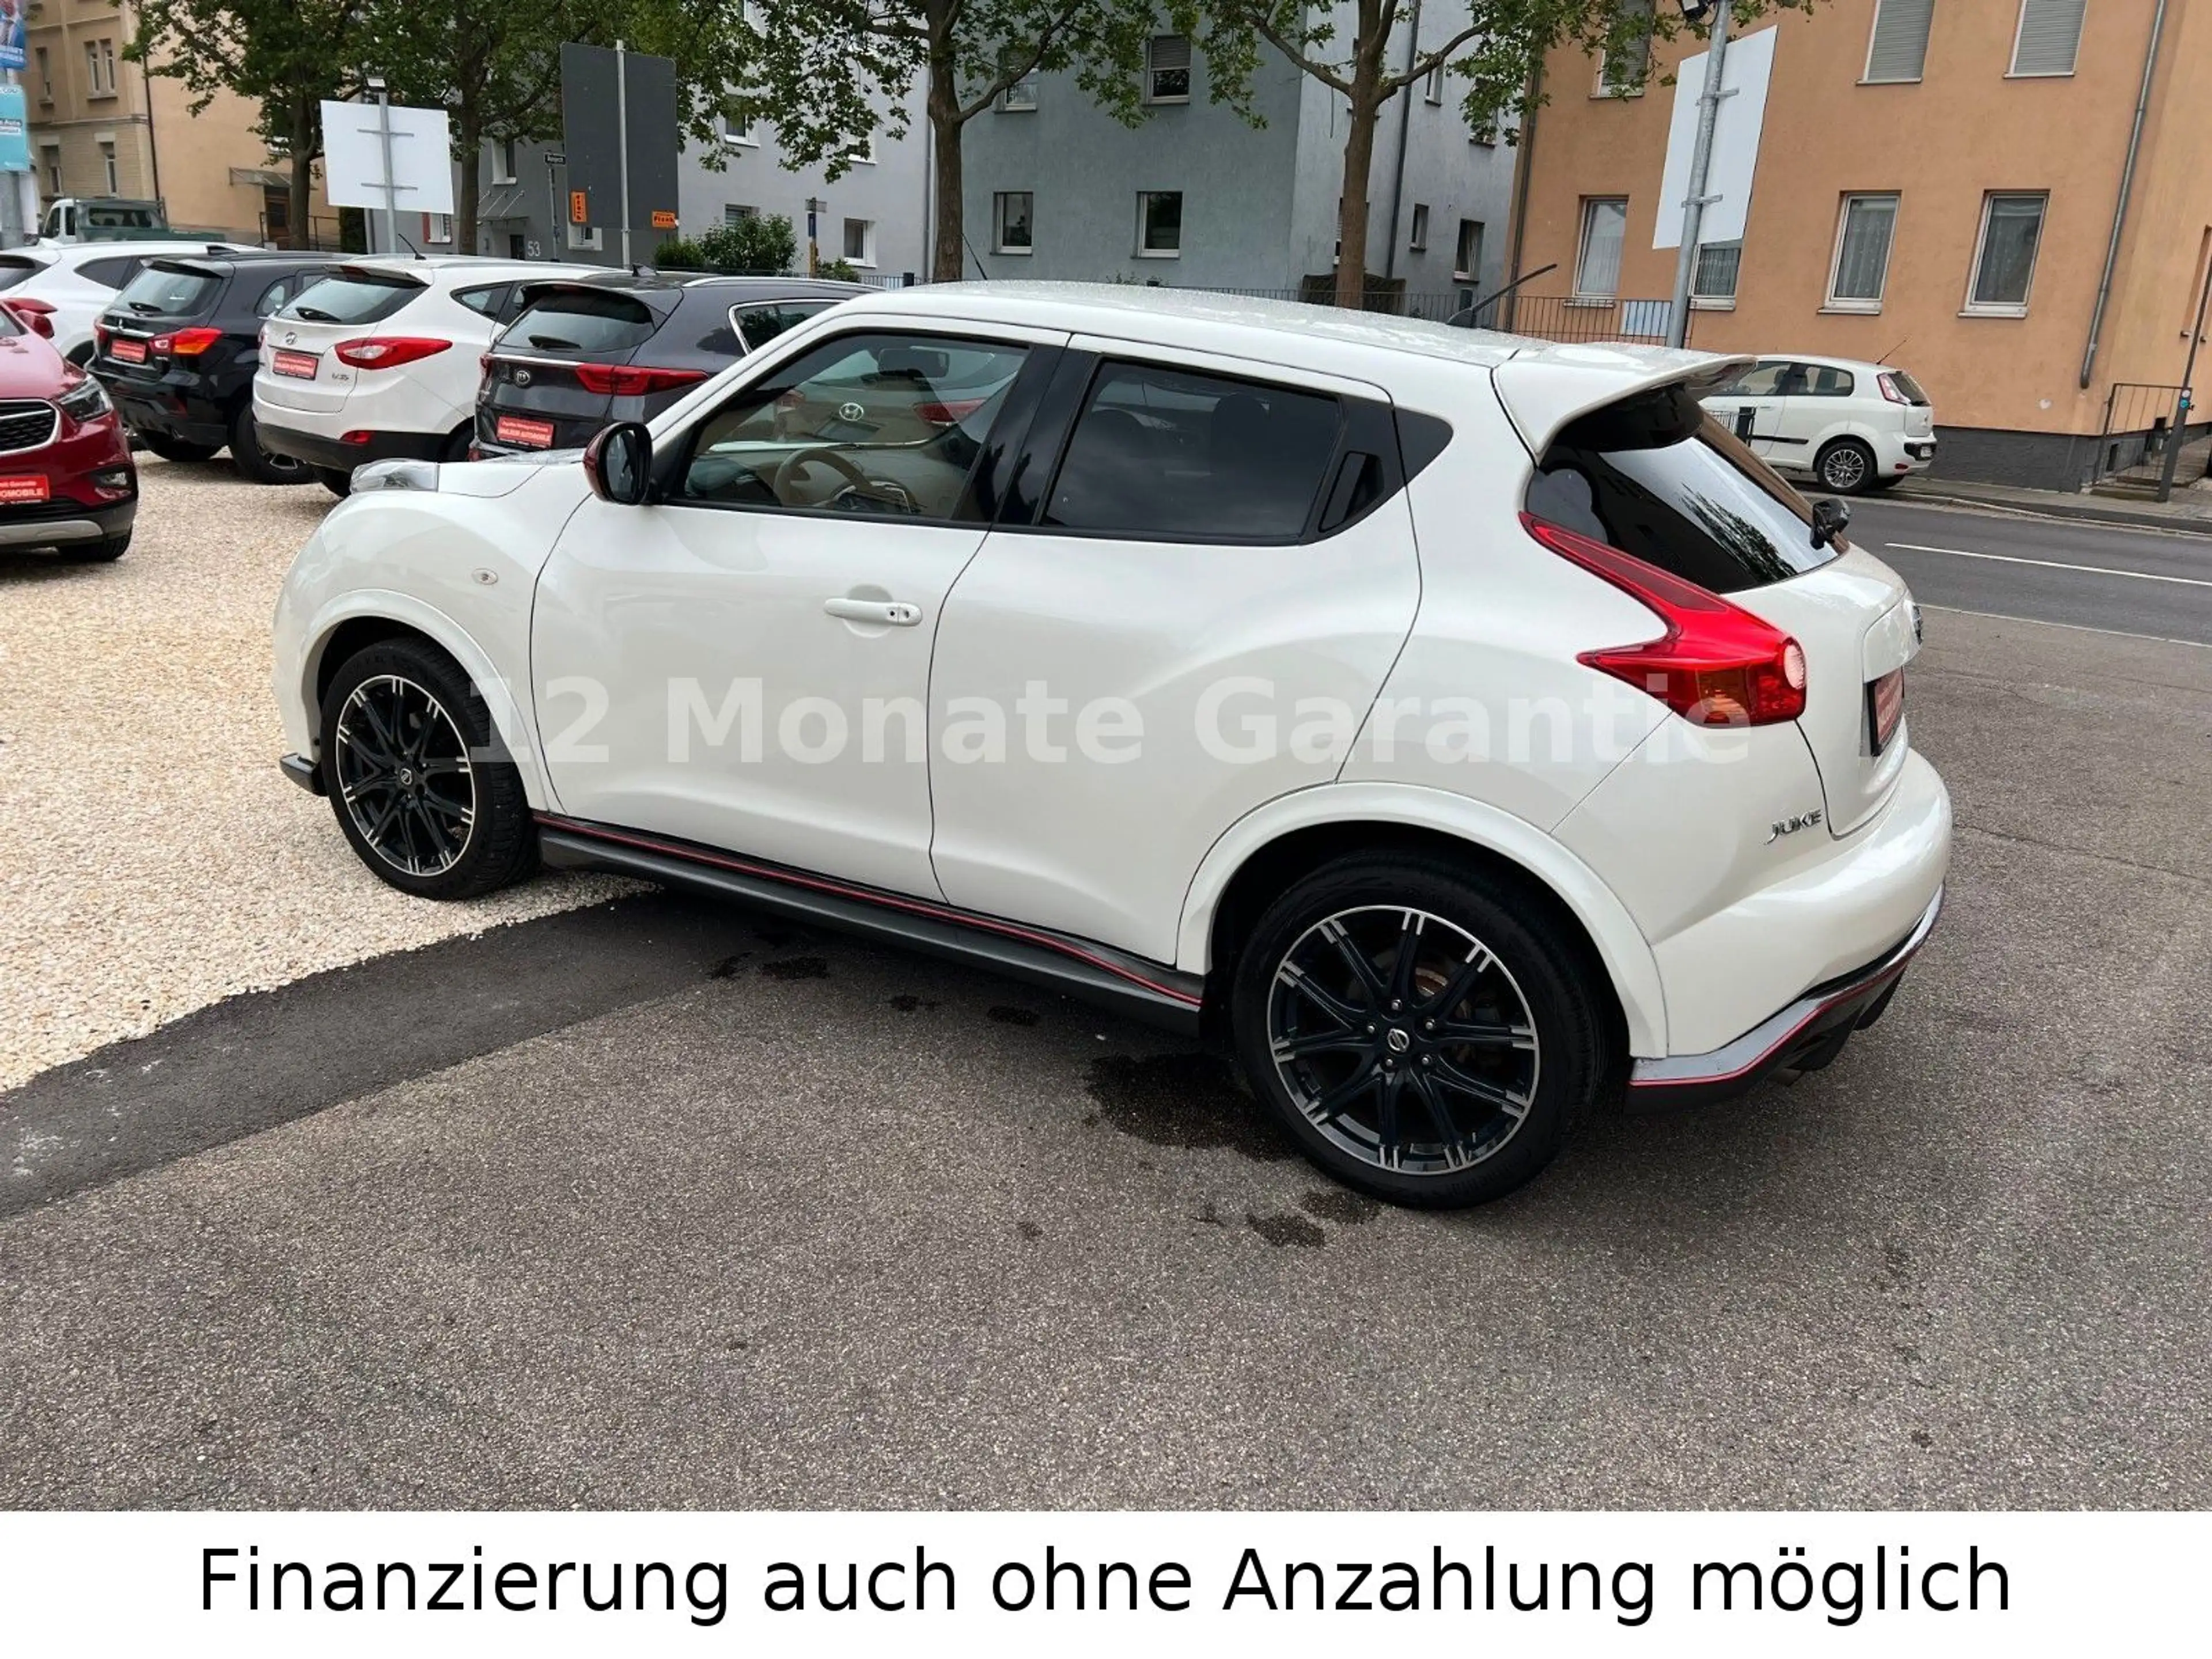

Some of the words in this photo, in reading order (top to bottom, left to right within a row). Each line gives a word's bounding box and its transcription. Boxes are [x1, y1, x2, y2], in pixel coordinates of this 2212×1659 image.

[527, 240, 541, 257] 53
[0, 487, 44, 498] OMOBILE
[1764, 809, 1821, 845] JUKE
